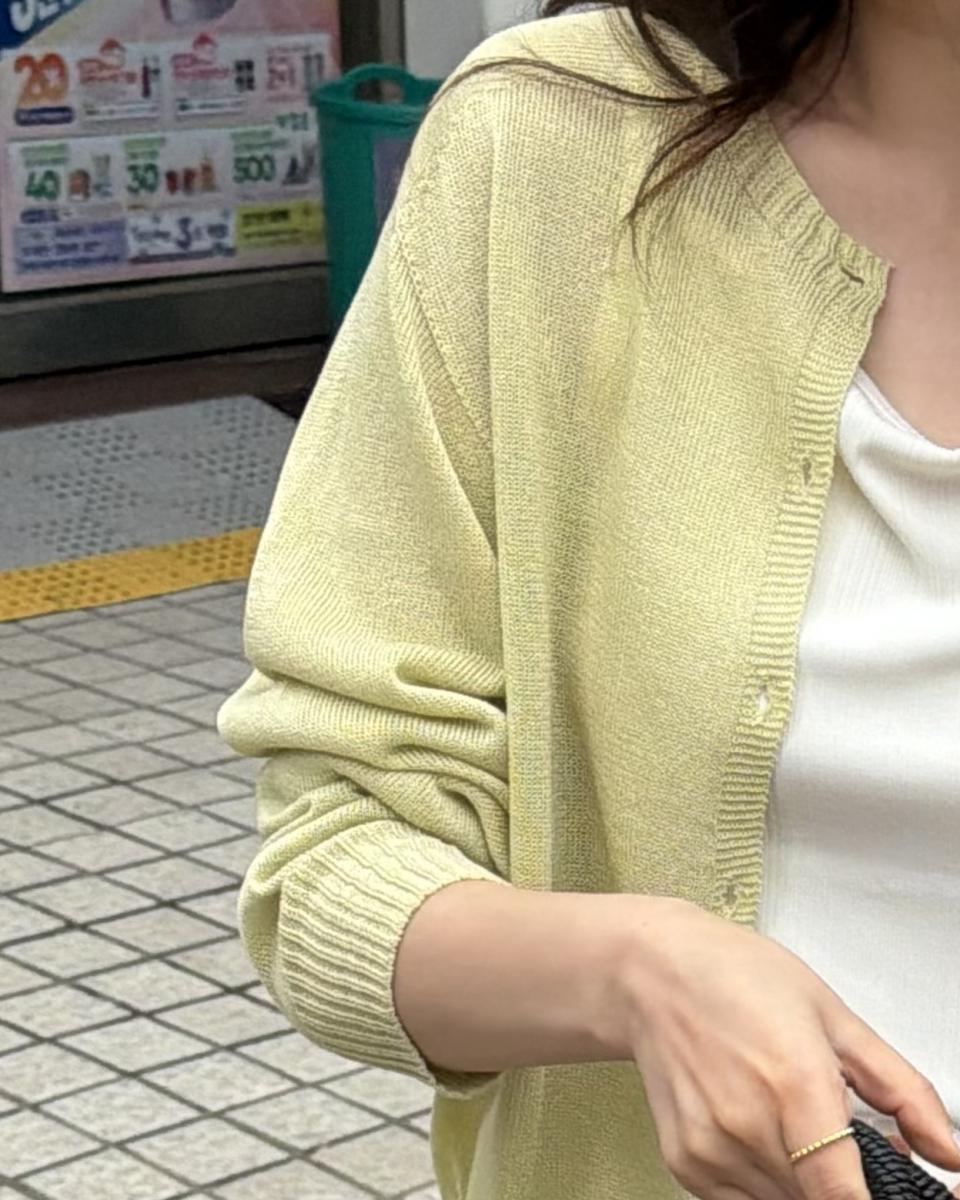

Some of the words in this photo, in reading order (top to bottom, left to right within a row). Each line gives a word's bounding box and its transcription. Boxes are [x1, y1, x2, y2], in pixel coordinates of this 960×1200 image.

[127, 162, 159, 193] 30
[233, 154, 275, 183] 500
[25, 169, 60, 200] 40
